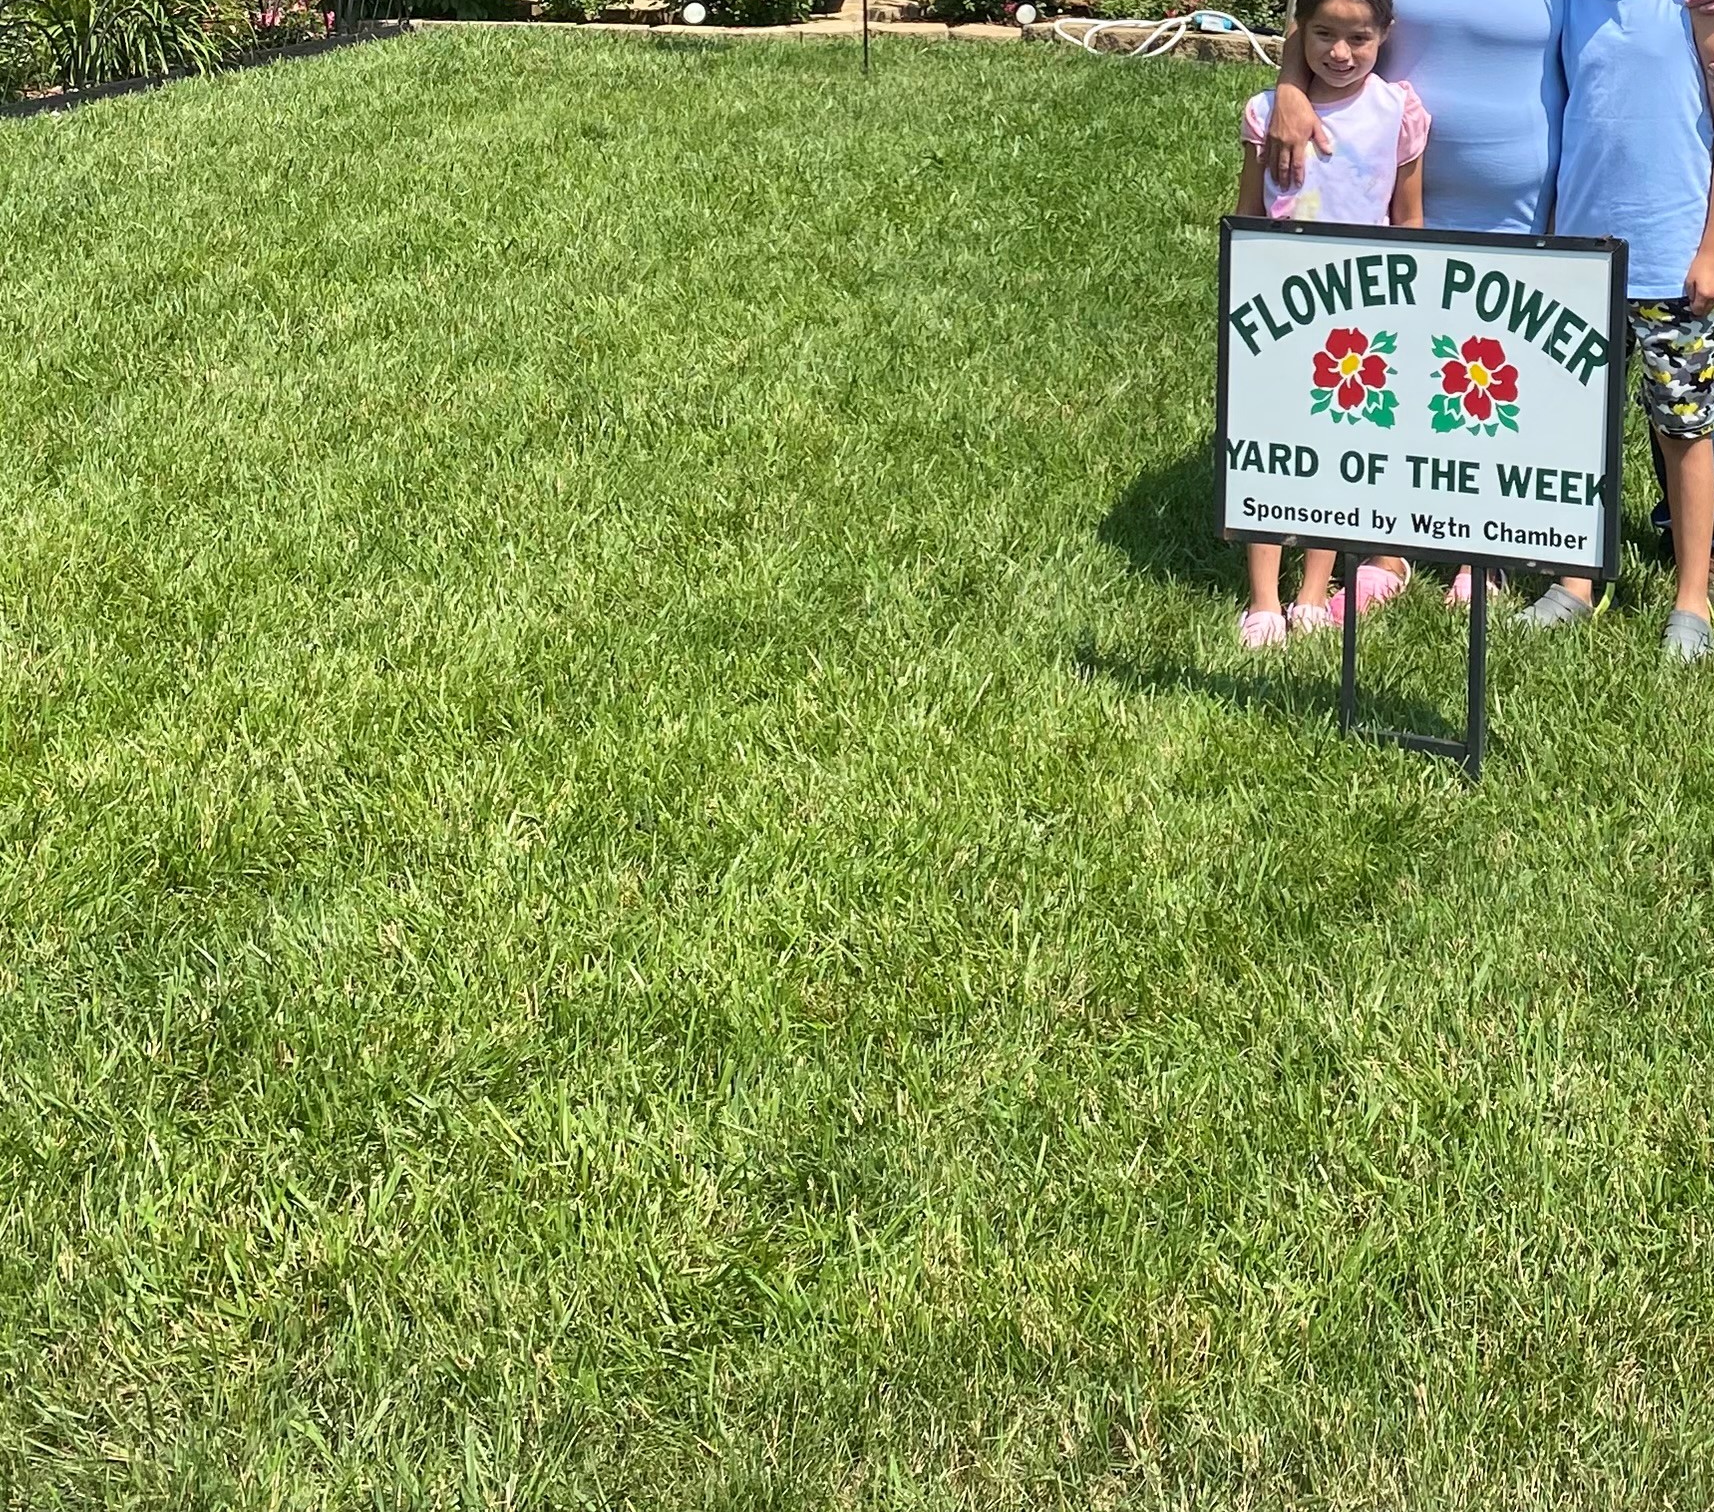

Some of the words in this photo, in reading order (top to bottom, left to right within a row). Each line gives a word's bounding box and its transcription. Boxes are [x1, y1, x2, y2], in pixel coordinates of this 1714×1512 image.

[1229, 254, 1418, 356] FLOWER
[1441, 258, 1611, 387] POWER
[1226, 438, 1319, 479] YARD
[1340, 450, 1389, 486] OF
[1405, 455, 1480, 494] THE
[1495, 463, 1607, 507] WEEK
[1242, 497, 1360, 528] Sponsored
[1371, 509, 1397, 535] by
[1411, 513, 1471, 540] Wgtn
[1483, 521, 1588, 551] Chamber
